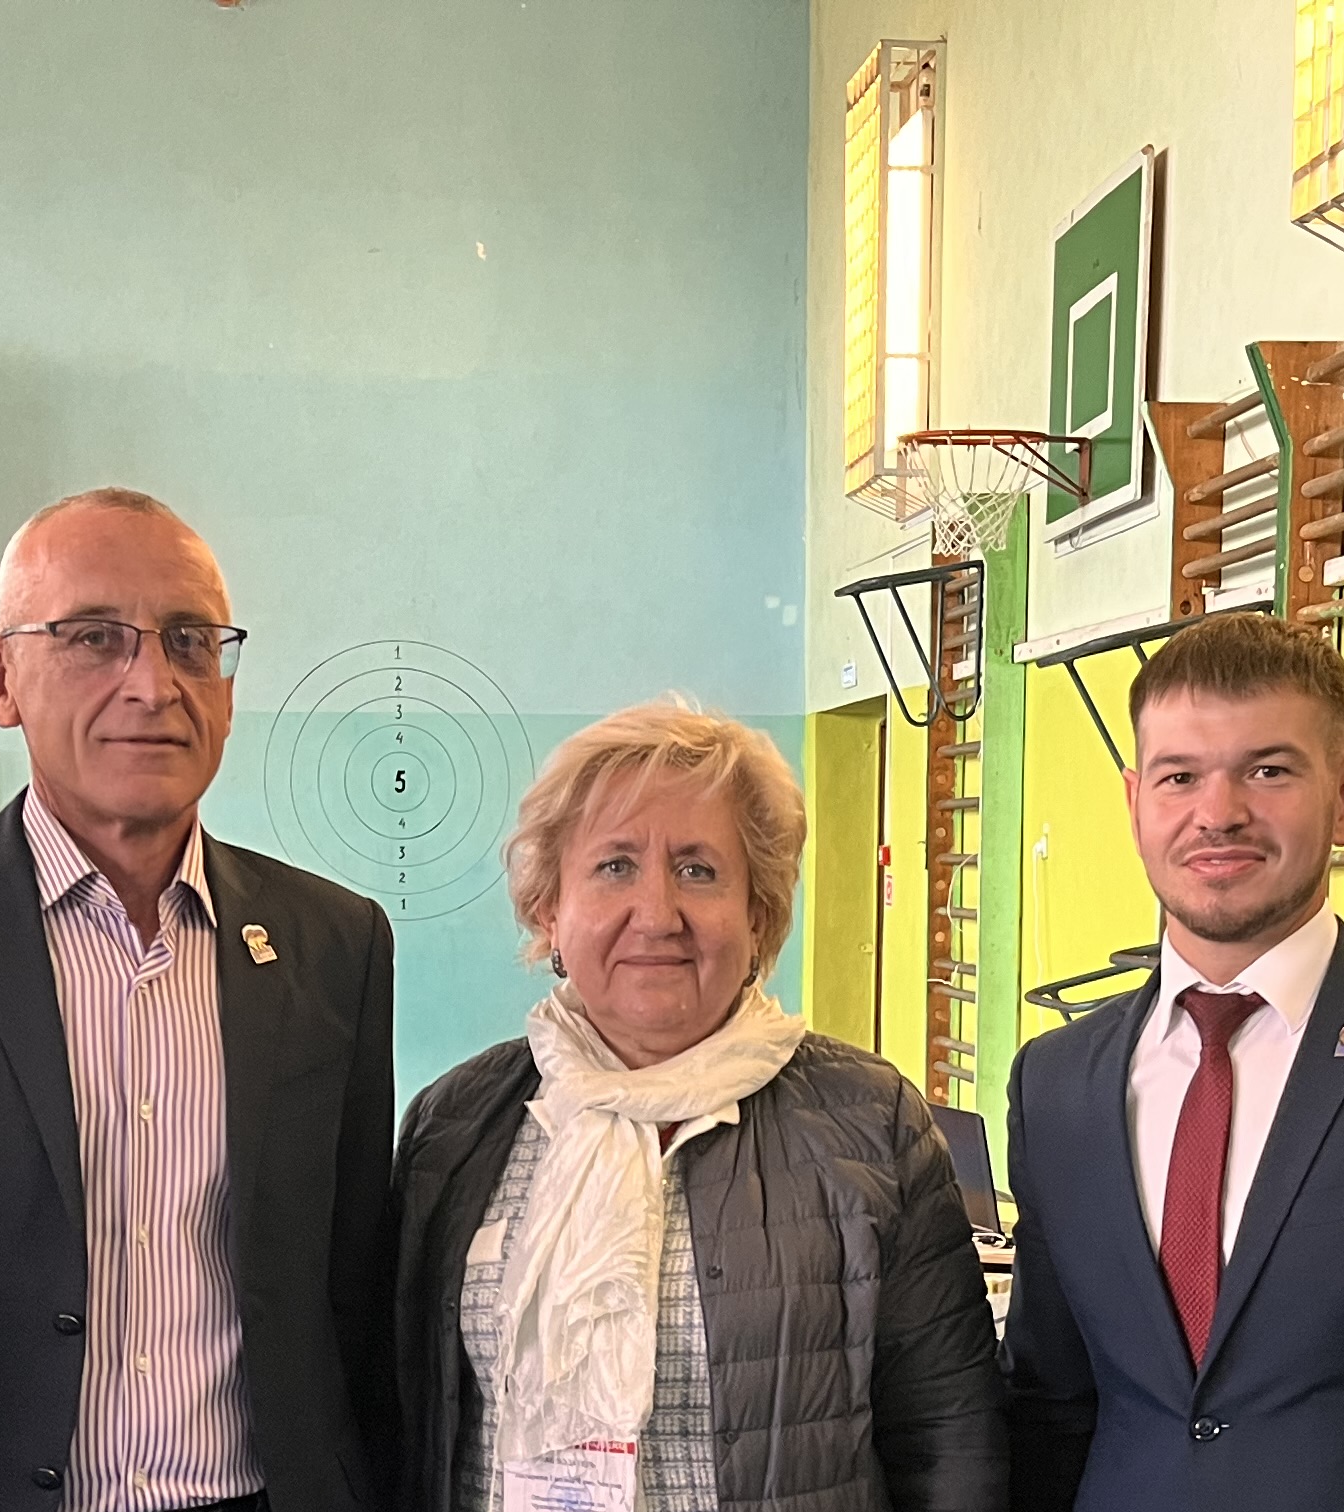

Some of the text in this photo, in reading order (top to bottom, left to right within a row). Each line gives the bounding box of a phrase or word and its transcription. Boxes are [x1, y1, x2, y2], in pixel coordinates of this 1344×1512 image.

[394, 645, 402, 660] 1
[395, 676, 402, 691] 2
[395, 704, 402, 719] 3
[396, 732, 403, 744] 4
[395, 770, 405, 793] 5
[399, 818, 405, 828] 4
[399, 846, 405, 859] 3
[399, 873, 405, 883] 2
